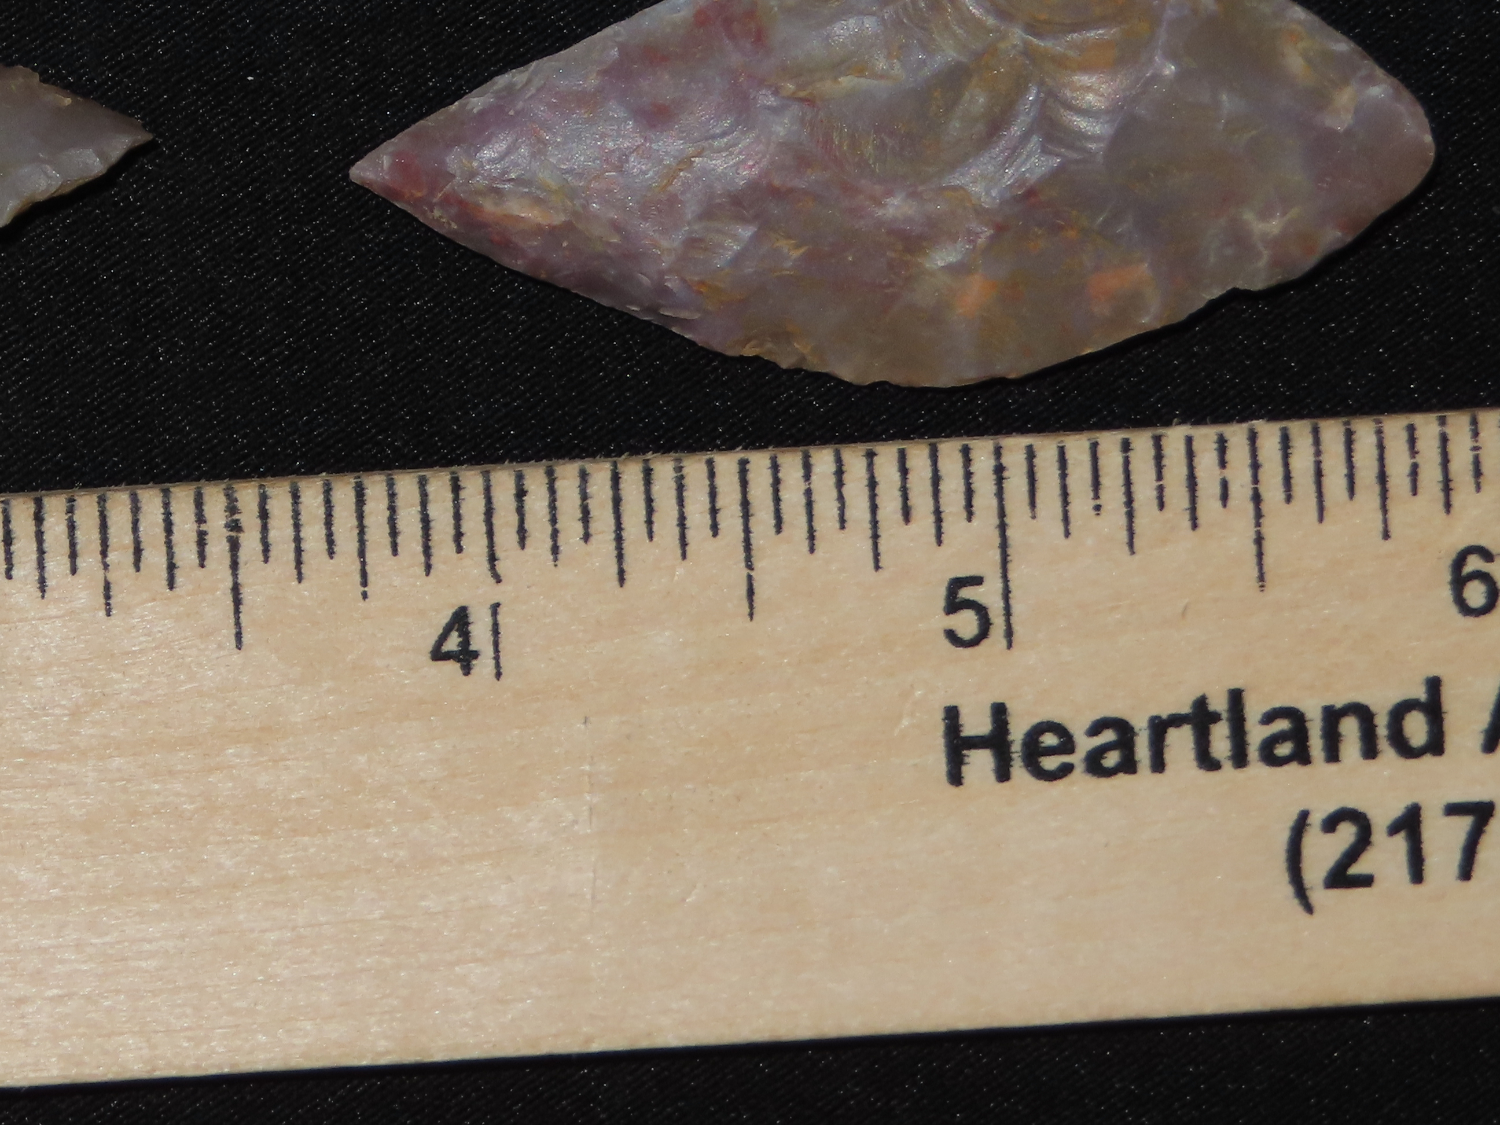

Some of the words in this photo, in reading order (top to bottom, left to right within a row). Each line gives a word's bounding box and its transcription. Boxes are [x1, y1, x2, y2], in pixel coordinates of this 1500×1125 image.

[941, 575, 993, 649] 5
[1448, 543, 1500, 618] 6
[428, 604, 481, 677] 4
[941, 675, 1446, 788] Heartland
[1284, 800, 1496, 916] (217
